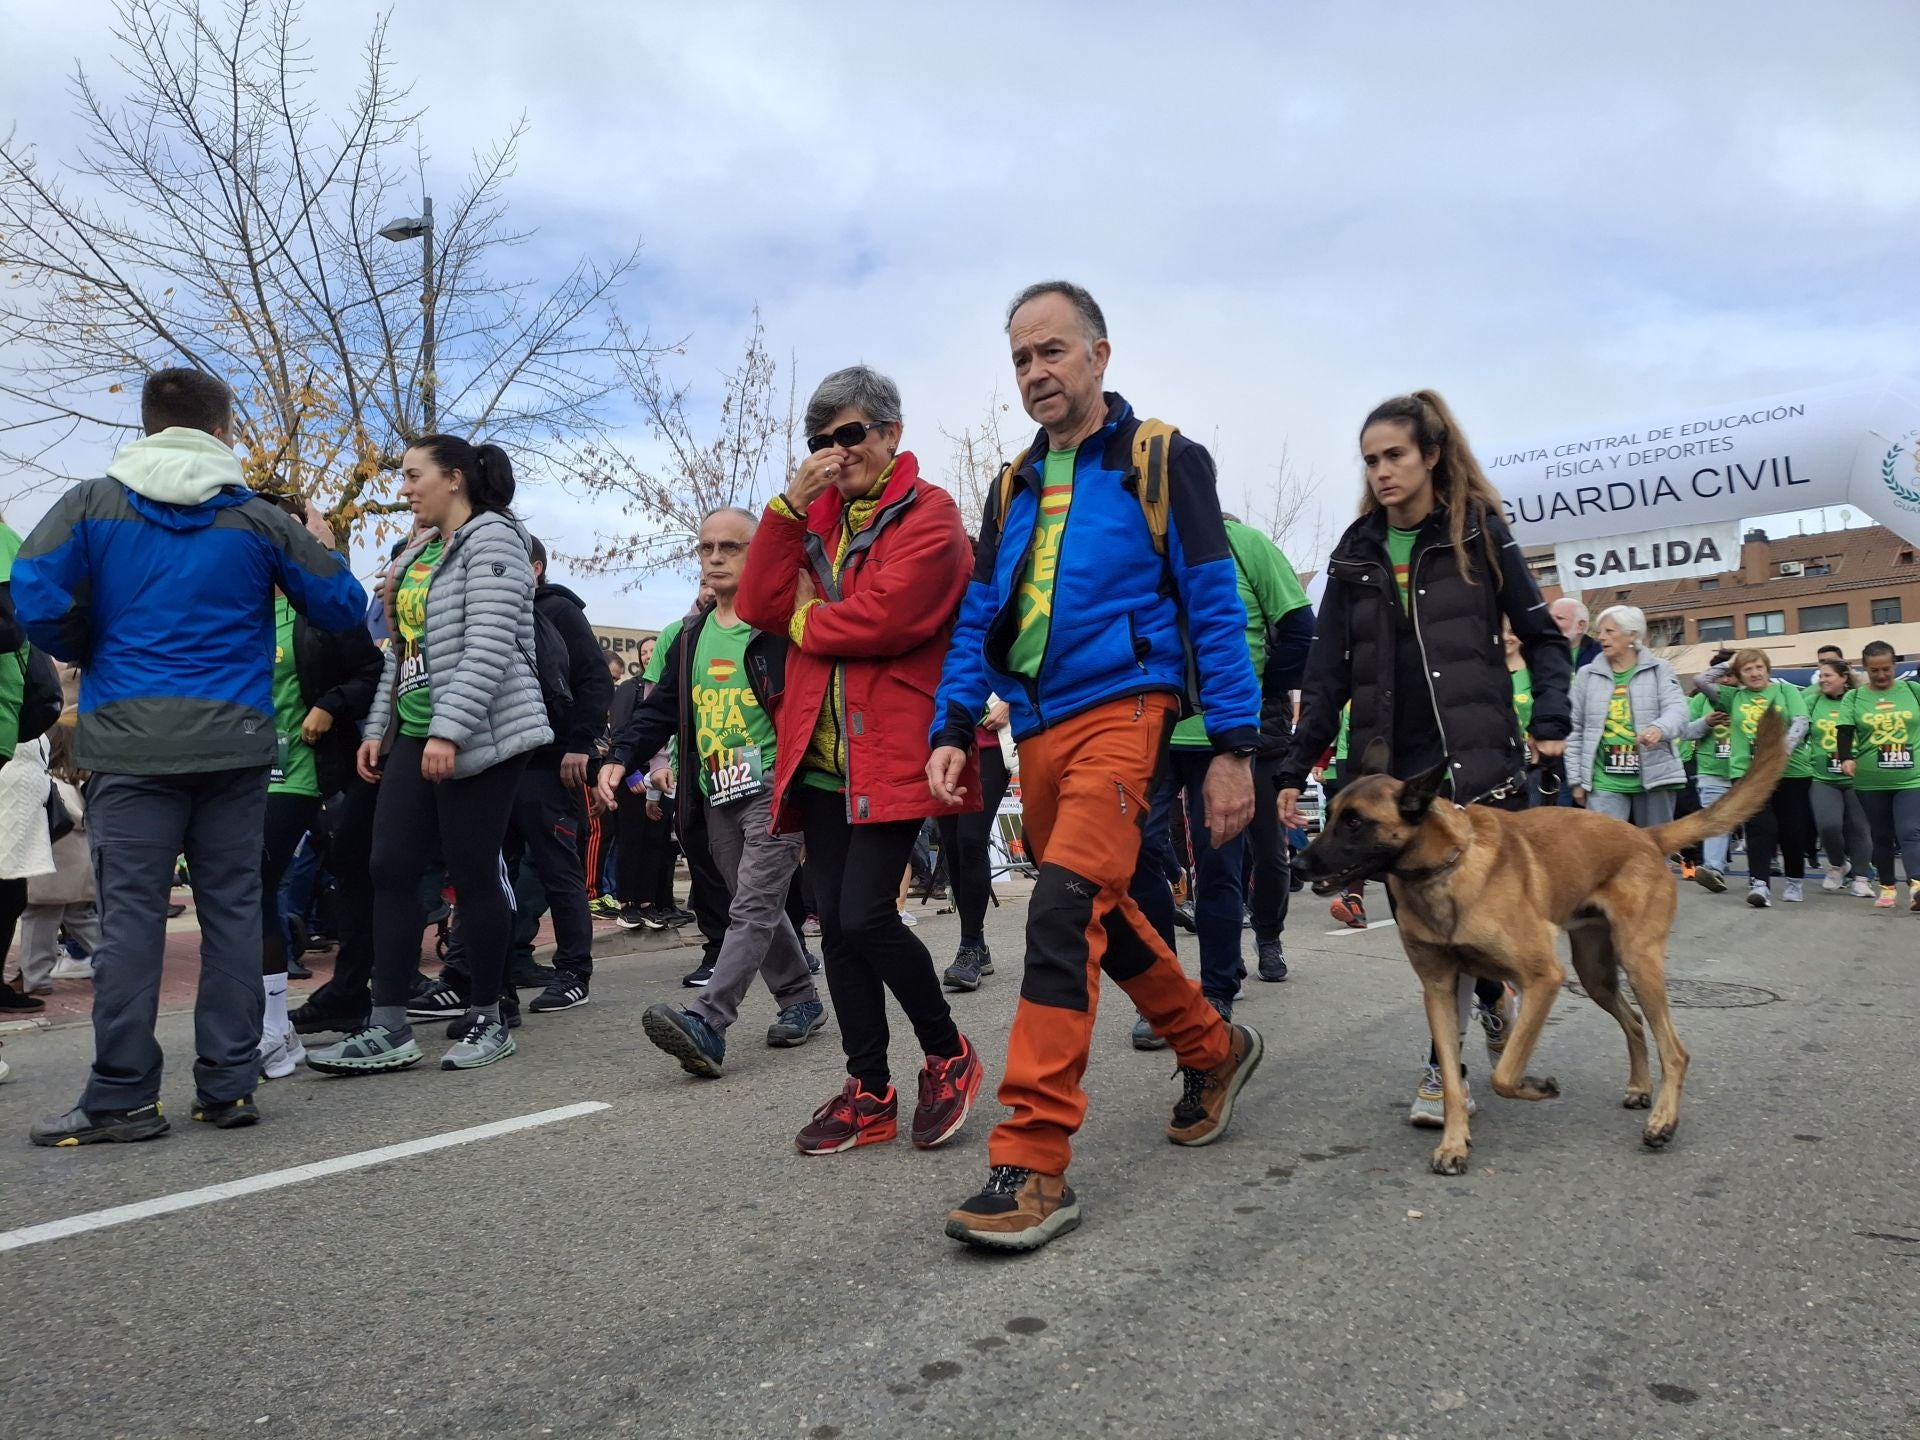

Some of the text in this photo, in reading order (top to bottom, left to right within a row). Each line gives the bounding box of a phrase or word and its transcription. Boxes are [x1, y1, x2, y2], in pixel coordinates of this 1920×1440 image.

[1489, 403, 1805, 469] JUNTA CENTRAL DE EDUCACIÓN
[1545, 435, 1735, 480] FÍSICA Y DEPORTES
[1501, 455, 1811, 525] GUARDIA CIVIL
[1574, 537, 1722, 578] SALIDA
[599, 635, 638, 652] DEP
[691, 684, 759, 707] Corre
[697, 705, 747, 729] TEA
[710, 762, 753, 792] 1022
